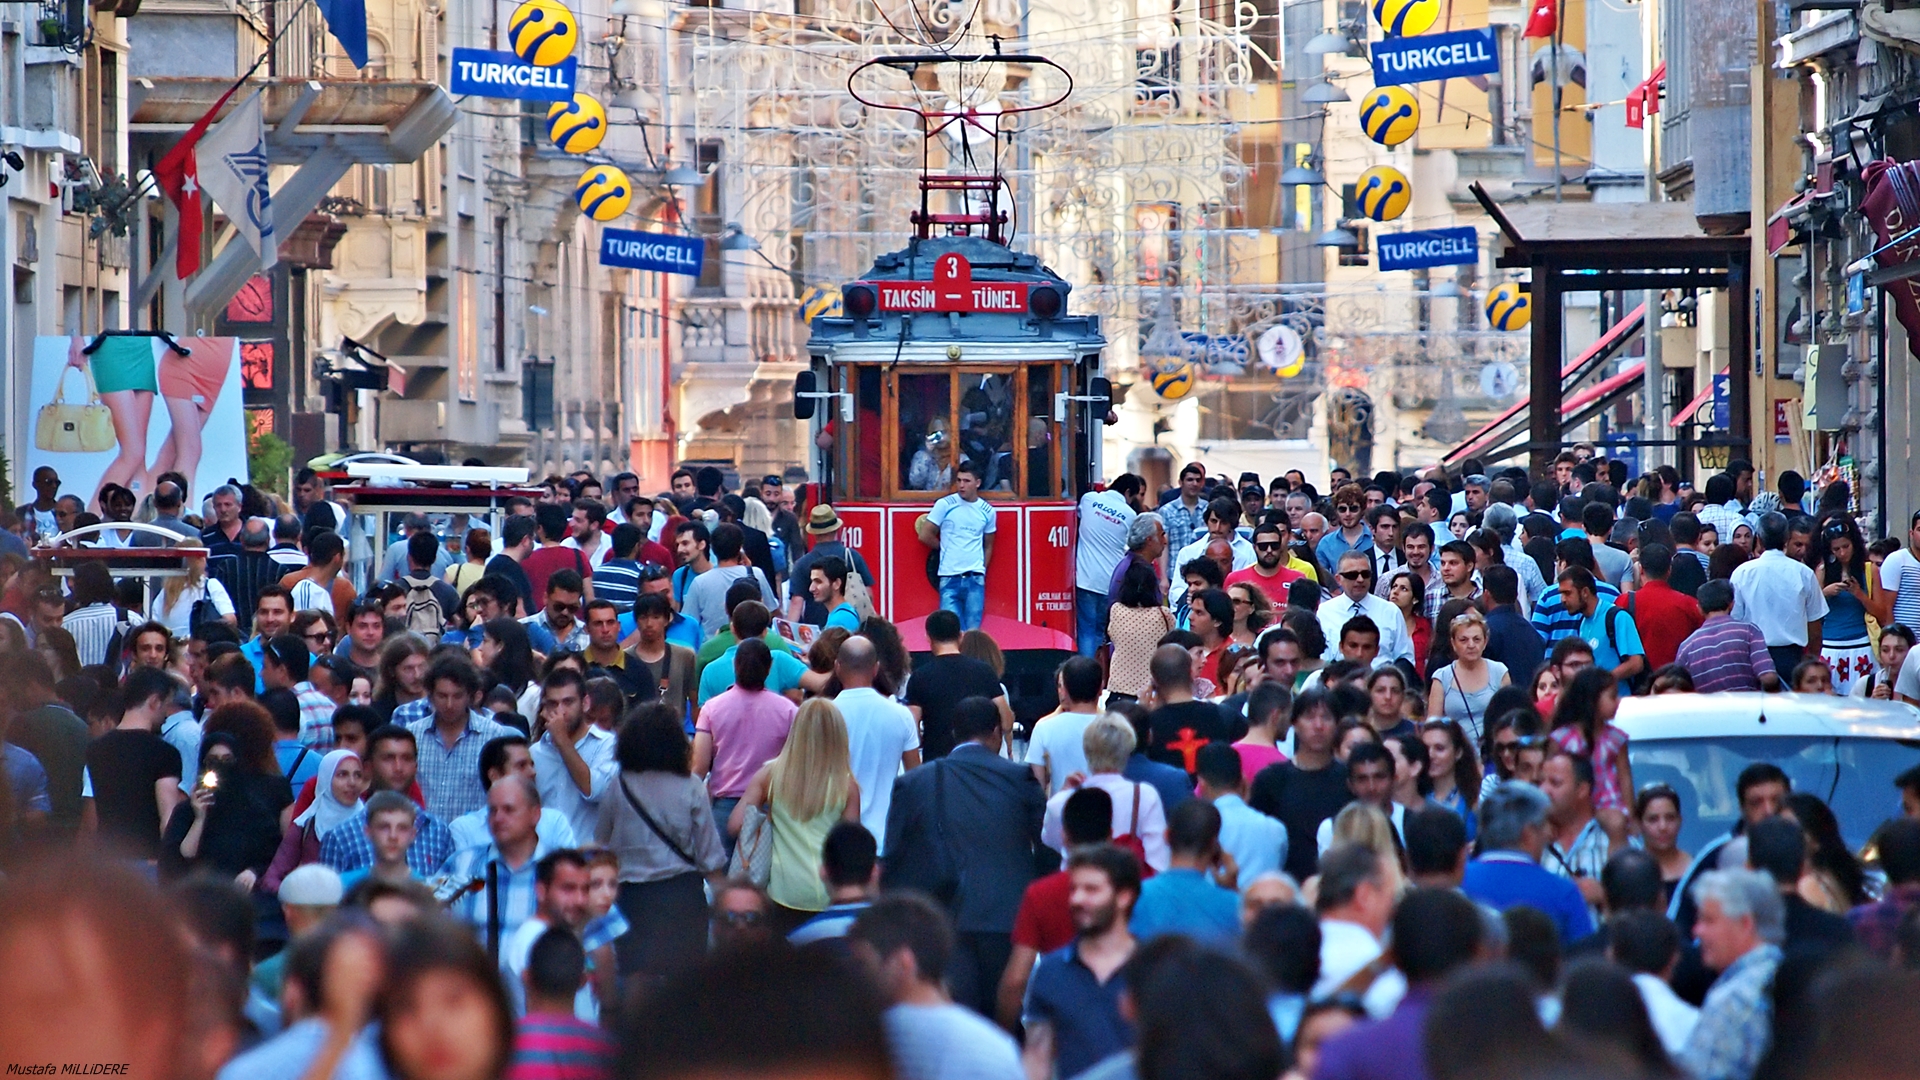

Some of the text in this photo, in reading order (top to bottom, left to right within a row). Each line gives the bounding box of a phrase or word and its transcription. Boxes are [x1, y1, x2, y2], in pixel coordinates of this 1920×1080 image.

[1377, 41, 1491, 73] TURKCELL
[458, 61, 569, 89] TURKCELL
[606, 238, 697, 265] TURKCELL
[1380, 237, 1474, 261] TURKCELL
[947, 257, 958, 279] 3
[882, 286, 936, 309] TAKSİM
[971, 287, 1022, 309] TÜNEL
[841, 526, 863, 549] 410
[1048, 526, 1069, 548] 410
